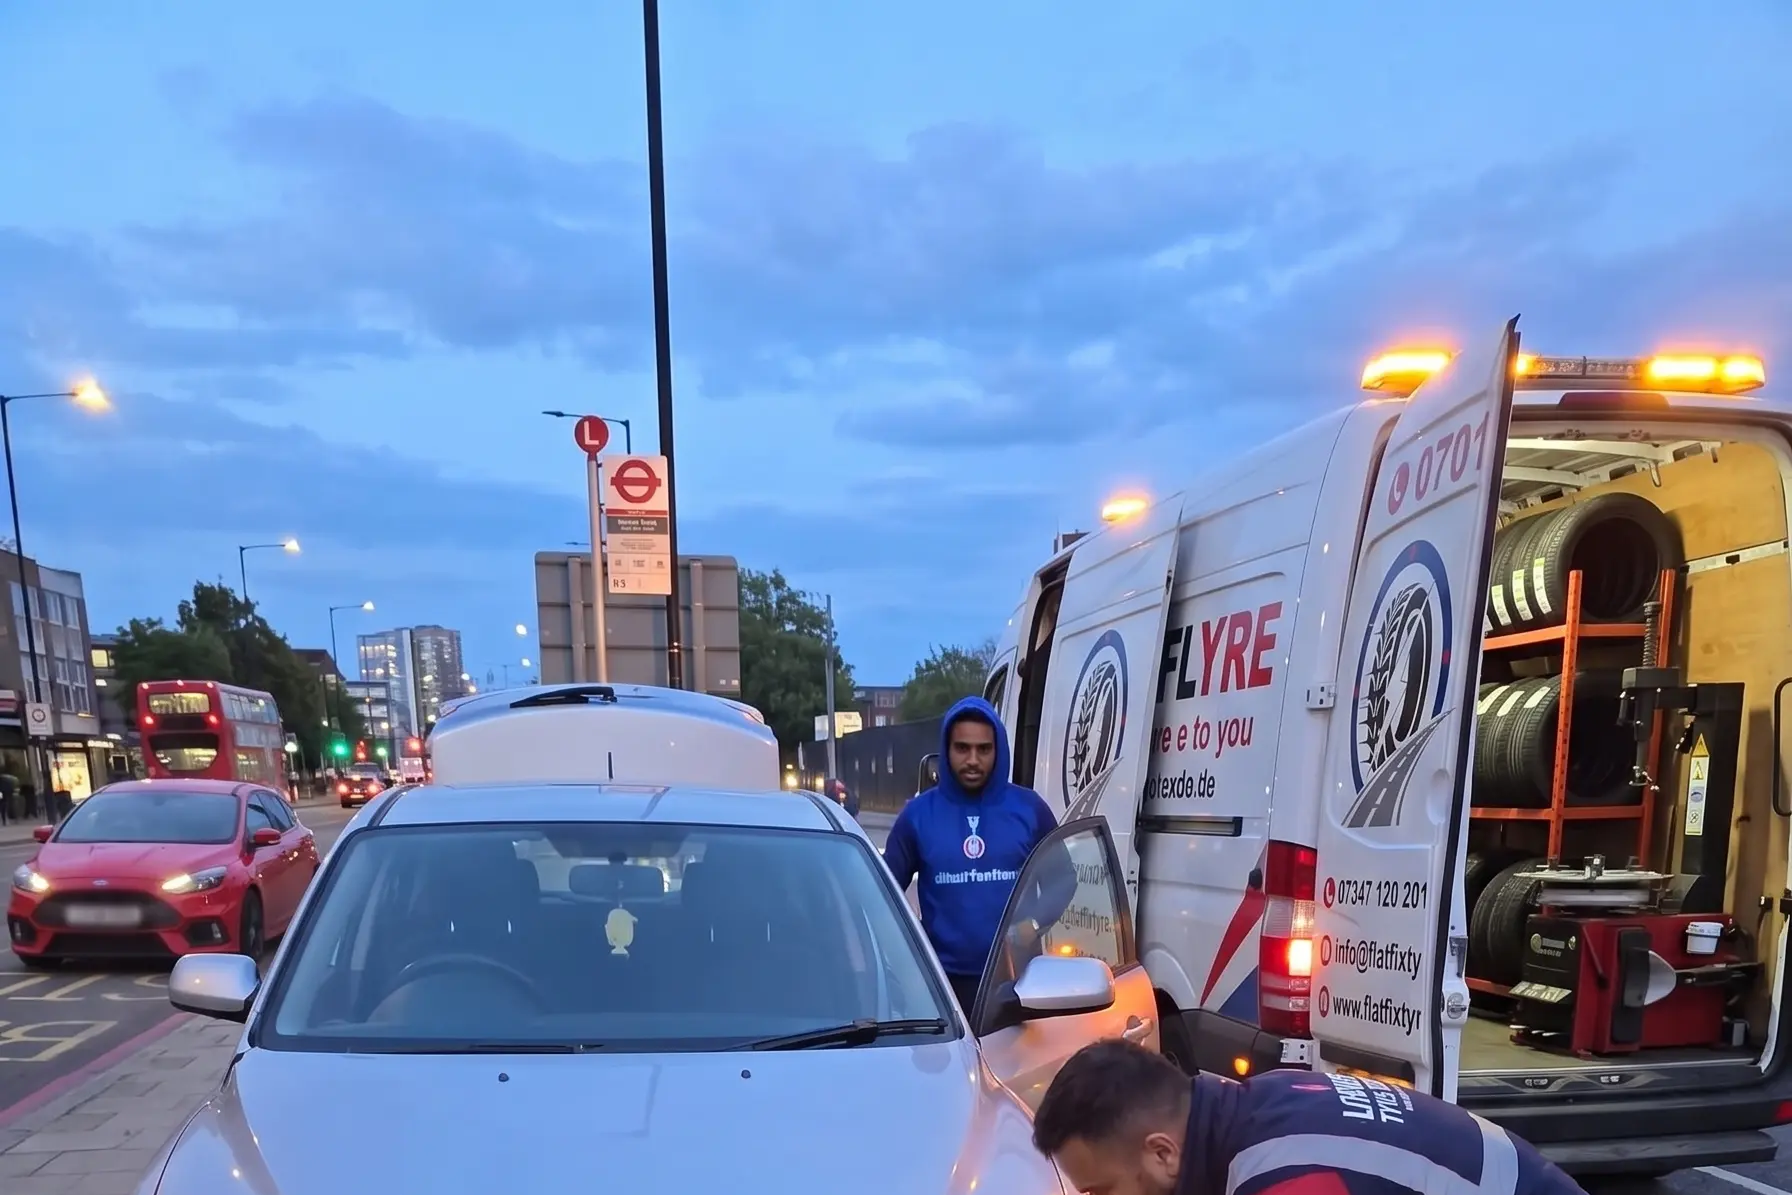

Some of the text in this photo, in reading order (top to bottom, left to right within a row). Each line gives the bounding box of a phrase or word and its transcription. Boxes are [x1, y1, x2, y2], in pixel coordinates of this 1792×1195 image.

[583, 420, 600, 446] L
[1415, 411, 1489, 501] 0701
[1193, 715, 1210, 750] to
[1215, 717, 1254, 759] you
[1338, 880, 1427, 909] 07347 120 201
